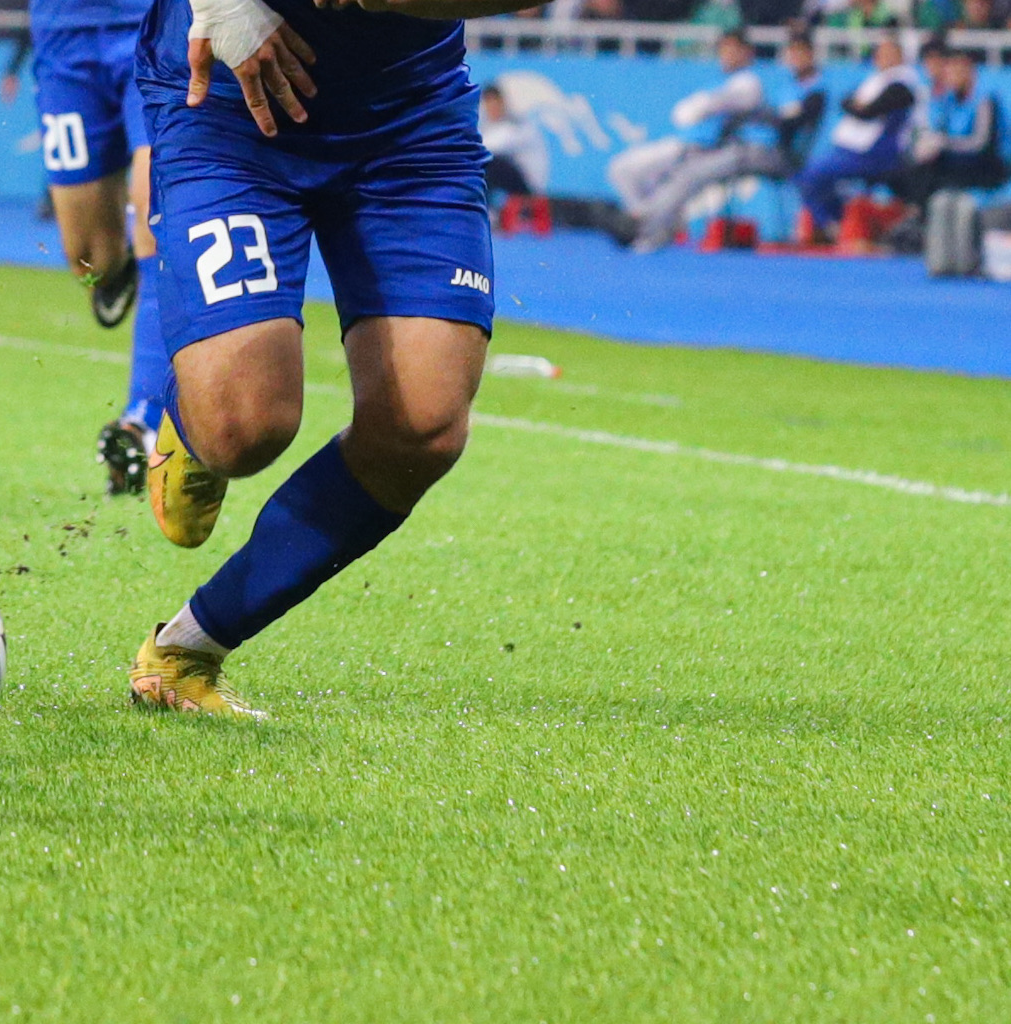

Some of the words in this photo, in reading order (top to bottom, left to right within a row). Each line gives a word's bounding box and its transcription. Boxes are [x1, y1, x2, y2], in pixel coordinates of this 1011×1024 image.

[42, 112, 88, 170] 20
[188, 214, 278, 305] 23
[450, 267, 490, 295] JAKO
